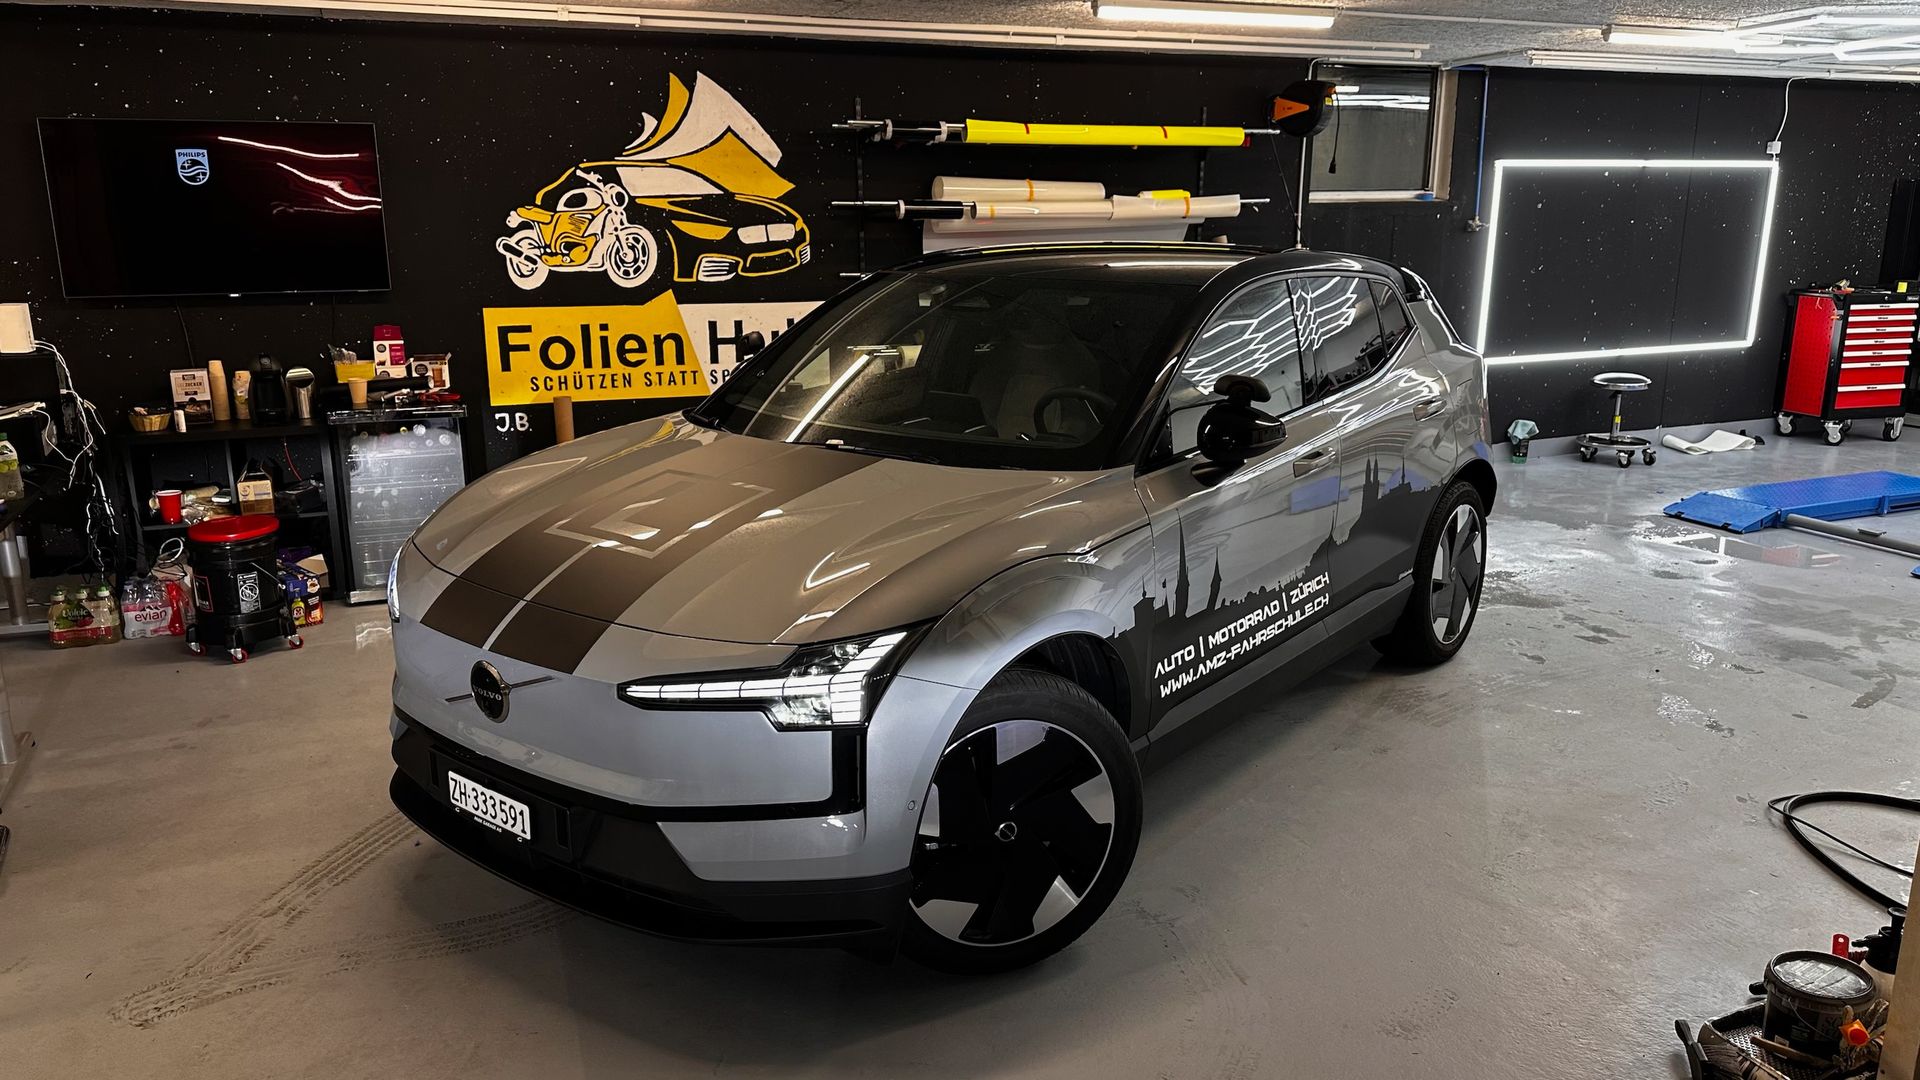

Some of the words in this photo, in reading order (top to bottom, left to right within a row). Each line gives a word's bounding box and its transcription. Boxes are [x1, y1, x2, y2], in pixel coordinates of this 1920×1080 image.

[496, 322, 687, 373] Folien
[530, 369, 633, 392] SCHÜTZEN
[644, 369, 700, 388] STATT
[709, 368, 731, 385] SP
[134, 608, 168, 623] evian
[1154, 645, 1195, 680] AUTO
[1208, 600, 1281, 654] MOTORRAD
[1289, 571, 1330, 604] ZÜRICH
[1160, 593, 1329, 698] WWW.AMZ-FAHRSCHULE.CH
[473, 685, 502, 701] VOLVO
